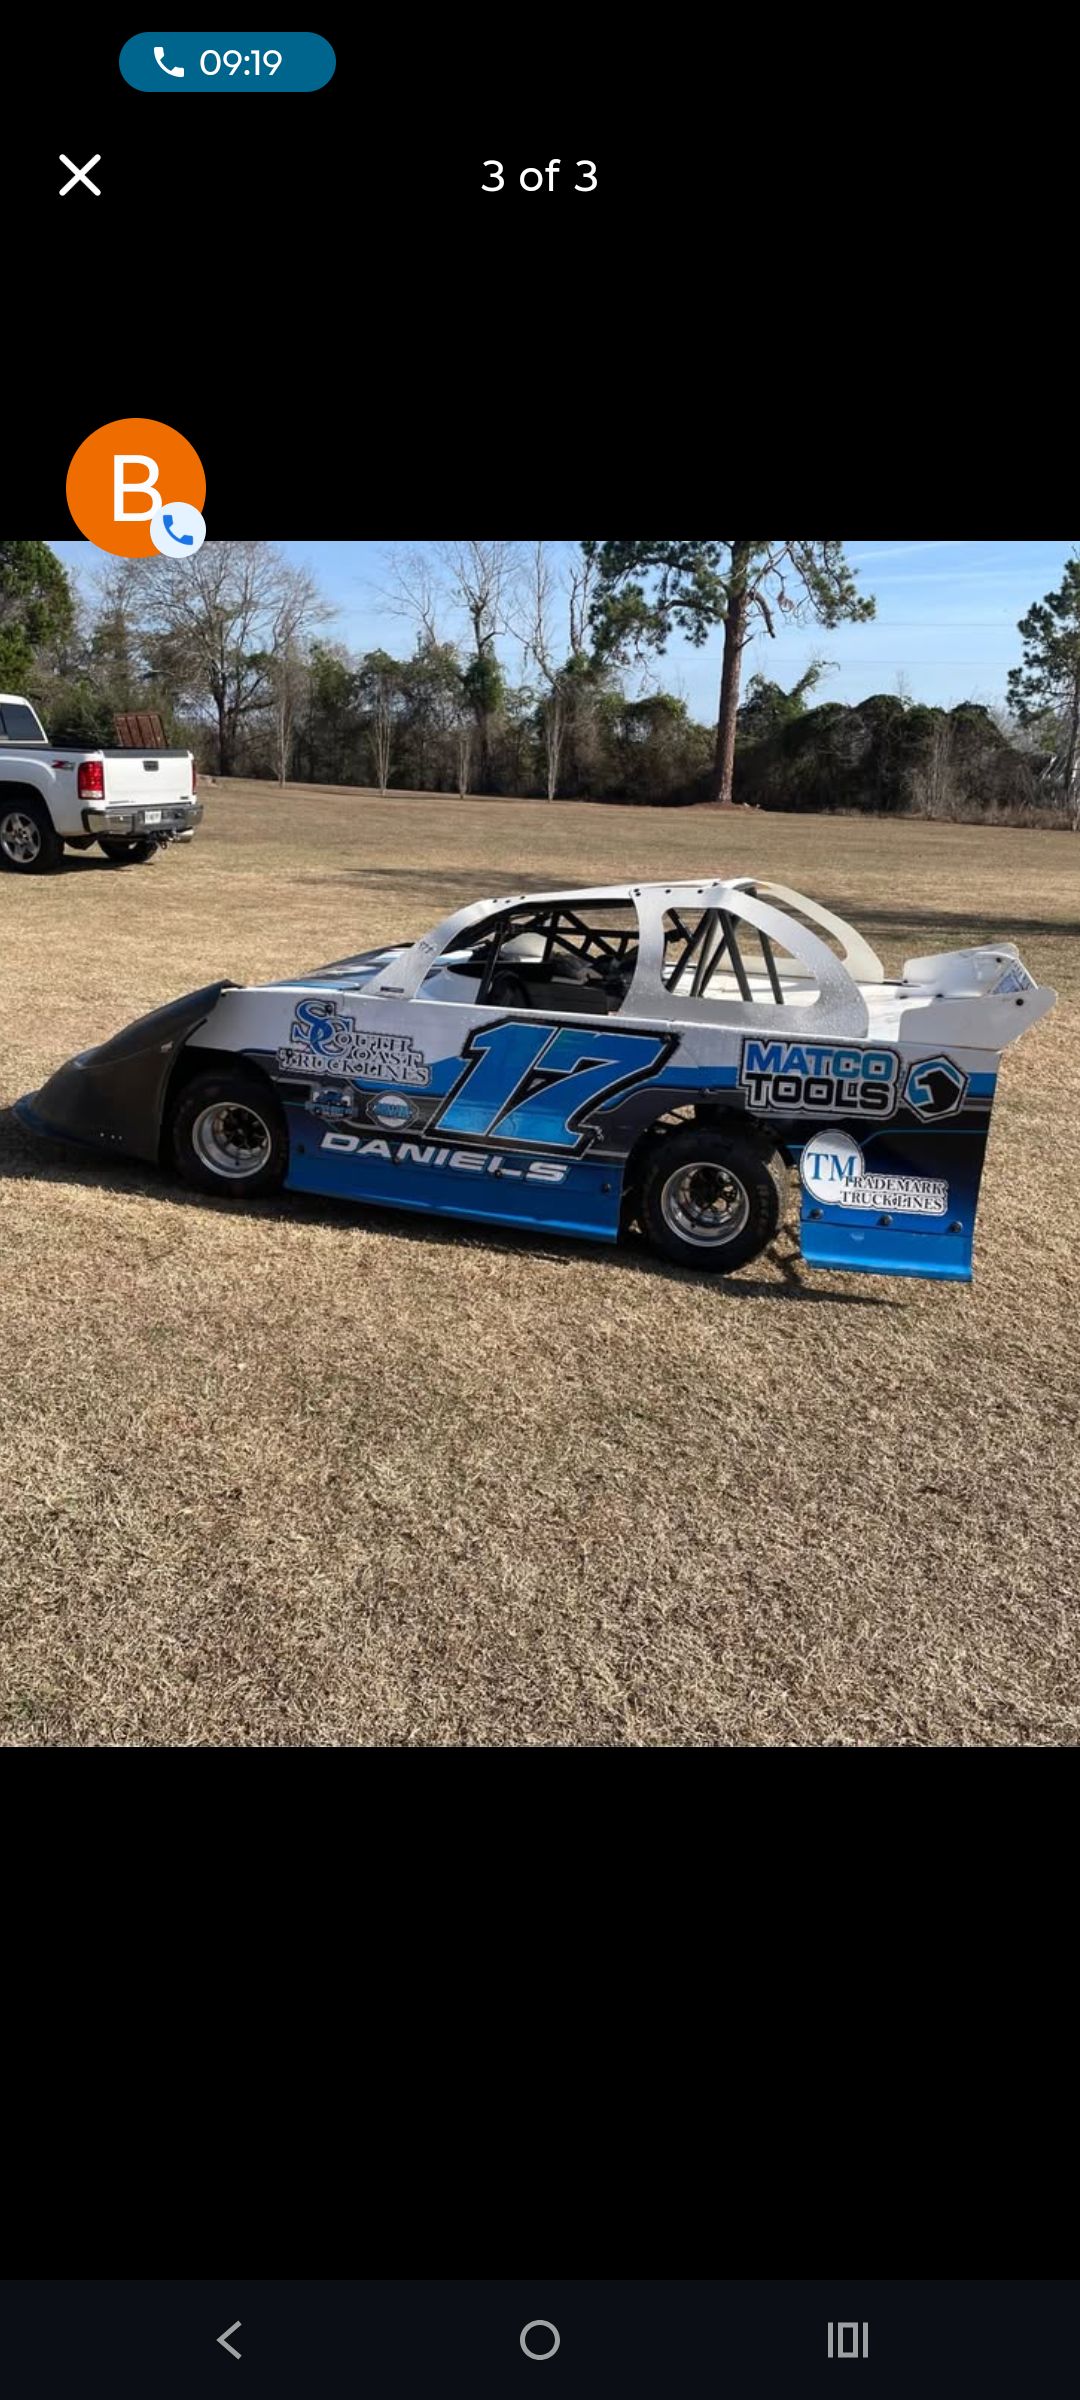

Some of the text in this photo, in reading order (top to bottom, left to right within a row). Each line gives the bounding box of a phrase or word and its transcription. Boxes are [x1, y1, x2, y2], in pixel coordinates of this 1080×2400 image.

[746, 1043, 894, 1082] MATCO
[434, 1021, 670, 1149] 17
[745, 1073, 890, 1110] TOOLS
[320, 1132, 567, 1183] DANIELS
[807, 1152, 857, 1183] TM
[843, 1175, 946, 1196] TRADEMARK
